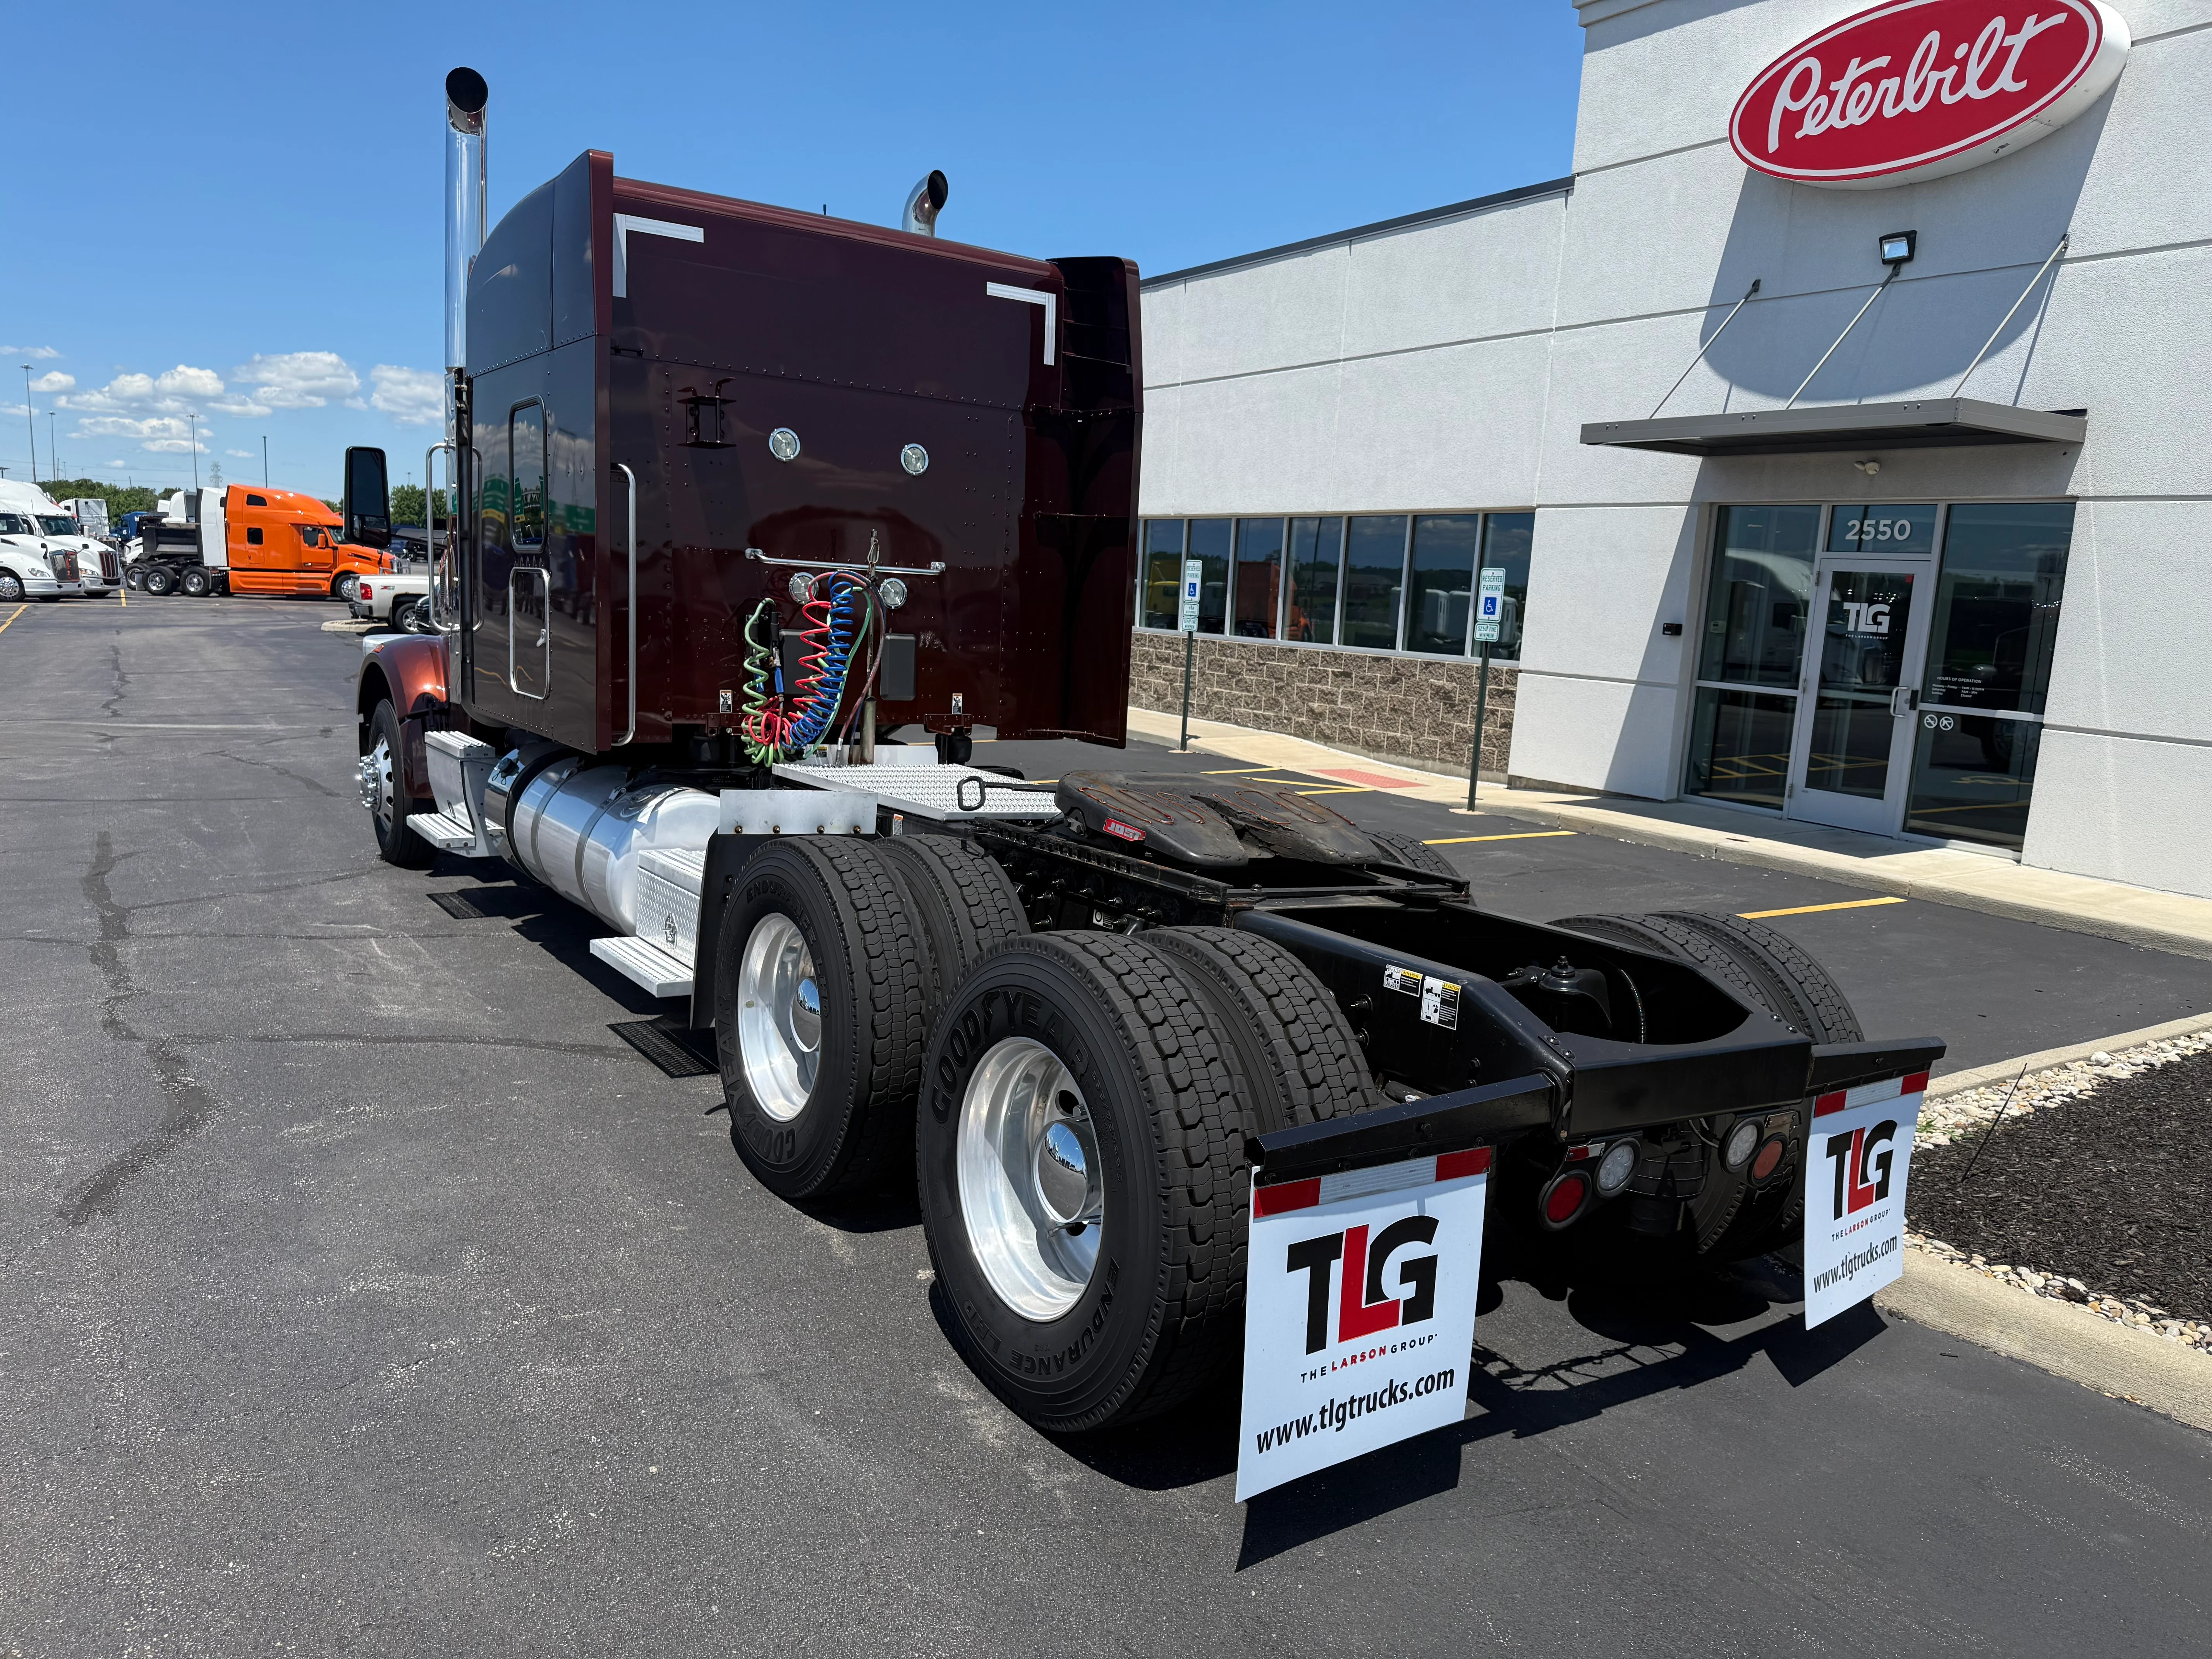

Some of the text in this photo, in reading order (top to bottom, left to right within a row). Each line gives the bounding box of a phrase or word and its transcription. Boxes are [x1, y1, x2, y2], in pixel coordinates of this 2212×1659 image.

[1768, 12, 2067, 153] Peterbilt
[1844, 519, 1911, 540] 2550
[1843, 602, 1891, 633] TLG
[1108, 822, 1142, 840] JOST
[746, 878, 830, 1019] ENDURANCE LHD
[717, 995, 797, 1163] GOODYEAR
[931, 990, 1091, 1123] GOODYEAR
[1826, 1119, 1898, 1221] TLG
[1813, 1235, 1898, 1294] www.tlgtrucks.com
[1831, 1209, 1889, 1242] THE LARSON GROUP
[964, 1299, 1002, 1355] LHD
[1009, 1256, 1120, 1376] ENDURANCE
[1286, 1214, 1440, 1356] TLG
[1300, 1334, 1435, 1384] THE LARSON GROUP
[1256, 1367, 1455, 1455] www.tlgtrucks.com
